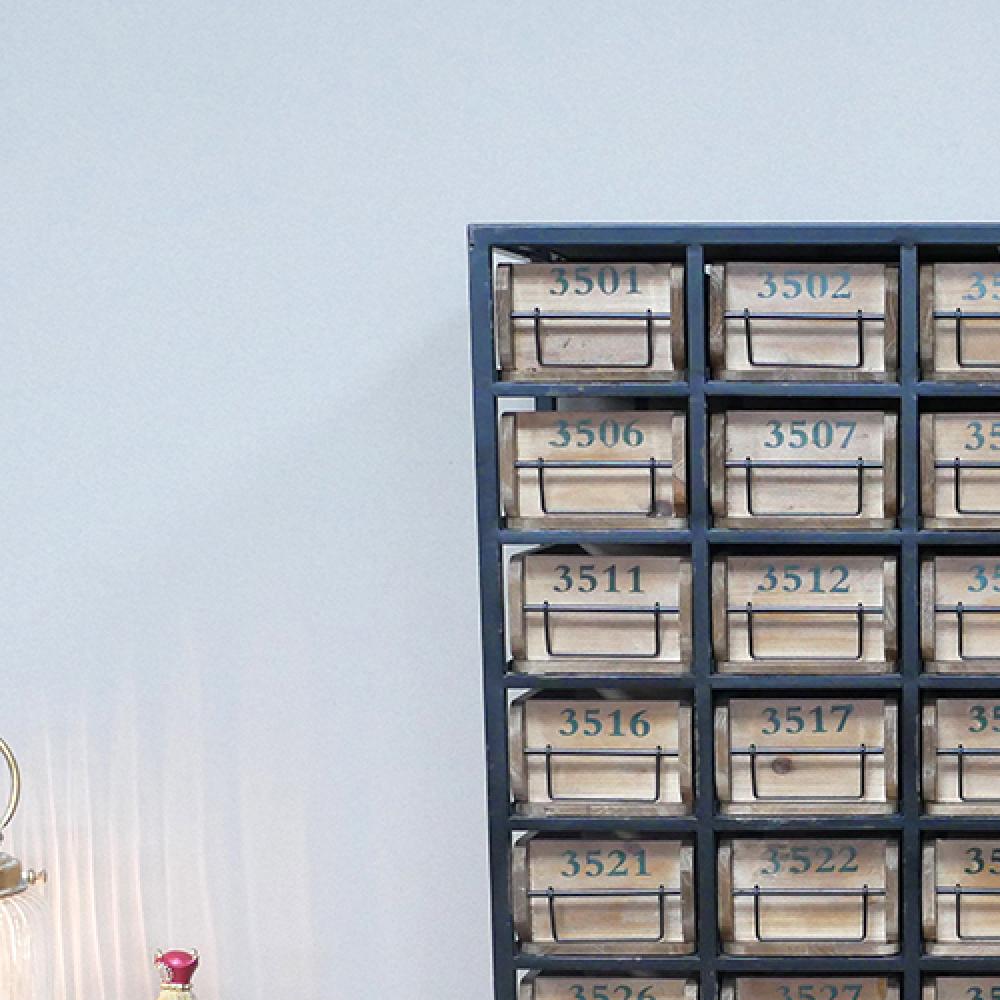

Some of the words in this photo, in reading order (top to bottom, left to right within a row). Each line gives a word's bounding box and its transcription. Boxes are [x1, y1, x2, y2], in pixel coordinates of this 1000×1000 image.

[549, 267, 642, 295] 3501
[757, 270, 852, 300] 3502
[549, 418, 645, 449] 3506
[764, 419, 856, 449] 3507
[552, 564, 645, 594] 3511
[757, 563, 850, 594] 3512
[559, 707, 651, 737] 3516
[762, 704, 854, 735] 3517
[561, 849, 649, 878] 3521
[761, 846, 858, 876] 3522
